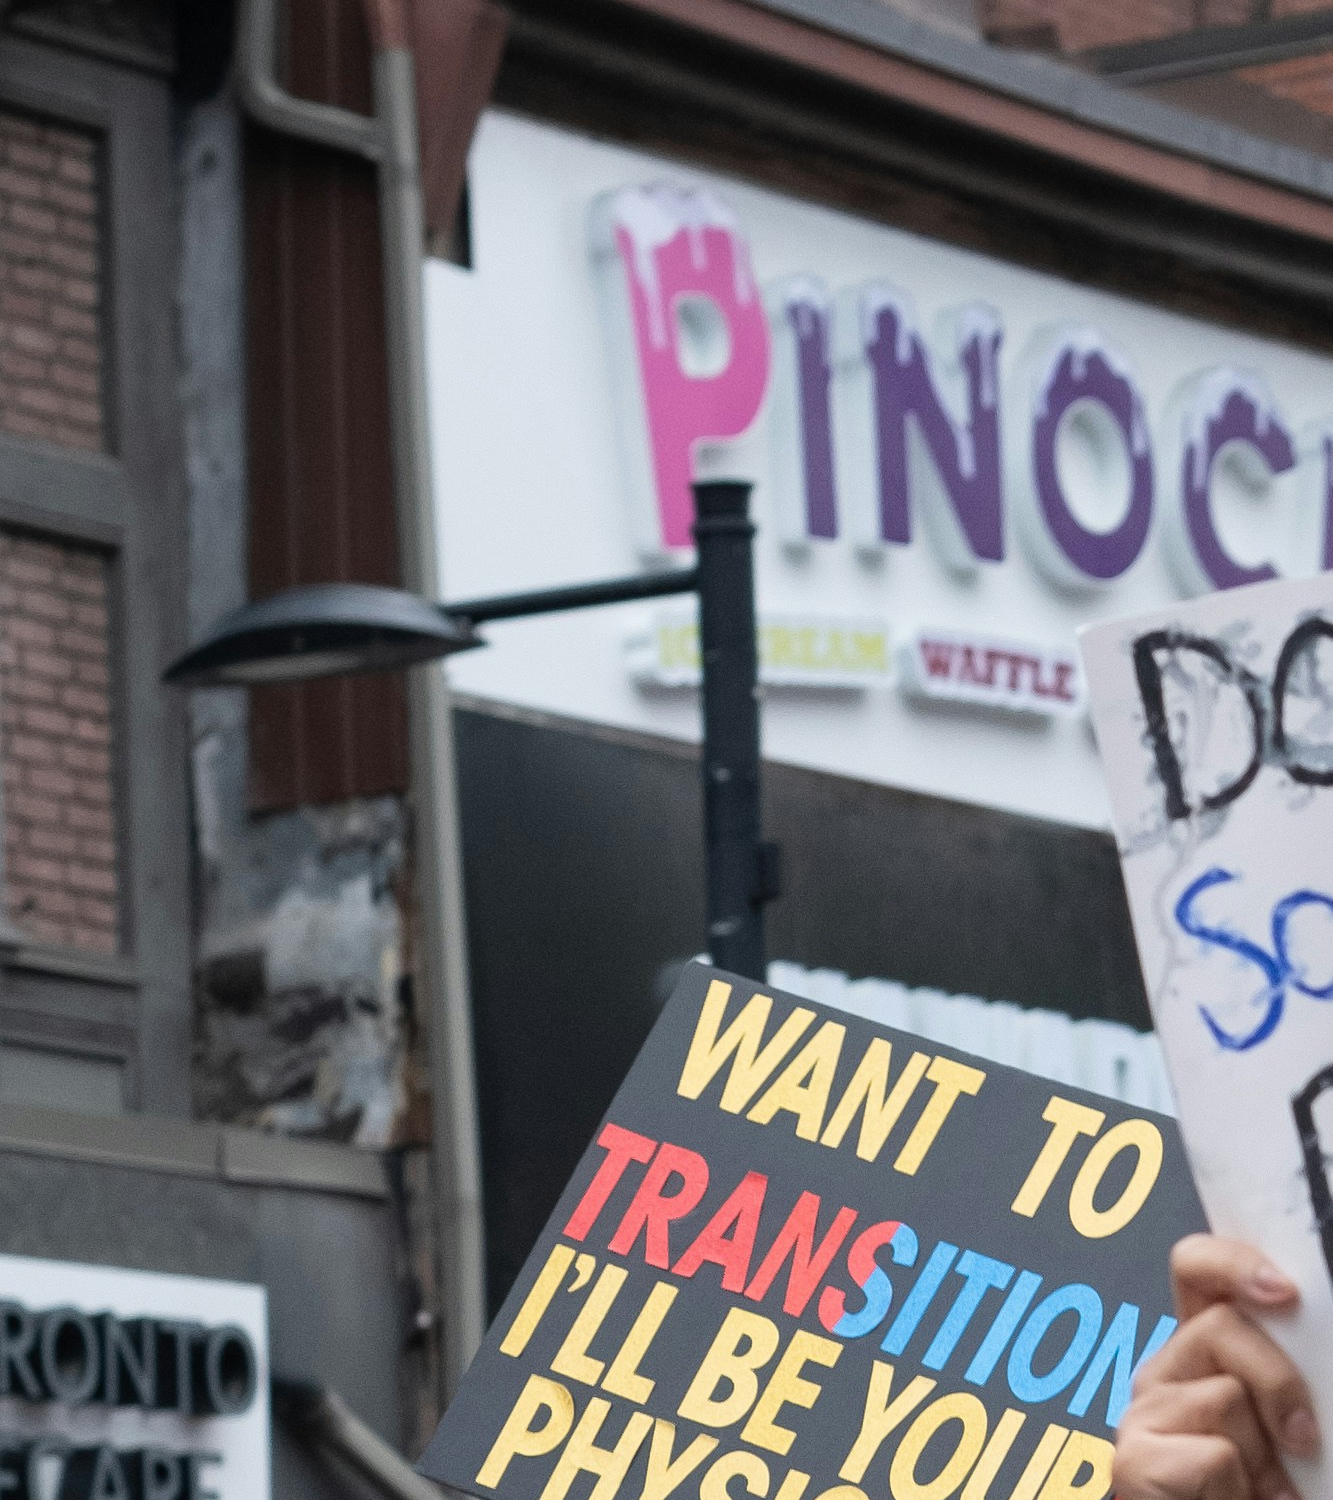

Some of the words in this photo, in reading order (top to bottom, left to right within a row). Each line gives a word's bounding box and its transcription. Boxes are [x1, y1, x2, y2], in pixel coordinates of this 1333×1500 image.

[676, 979, 986, 1176] WANT
[1010, 1095, 1163, 1240] TO
[498, 1245, 676, 1405] I'LL
[676, 1306, 844, 1456] BE
[562, 1124, 1178, 1427] TRANSITION
